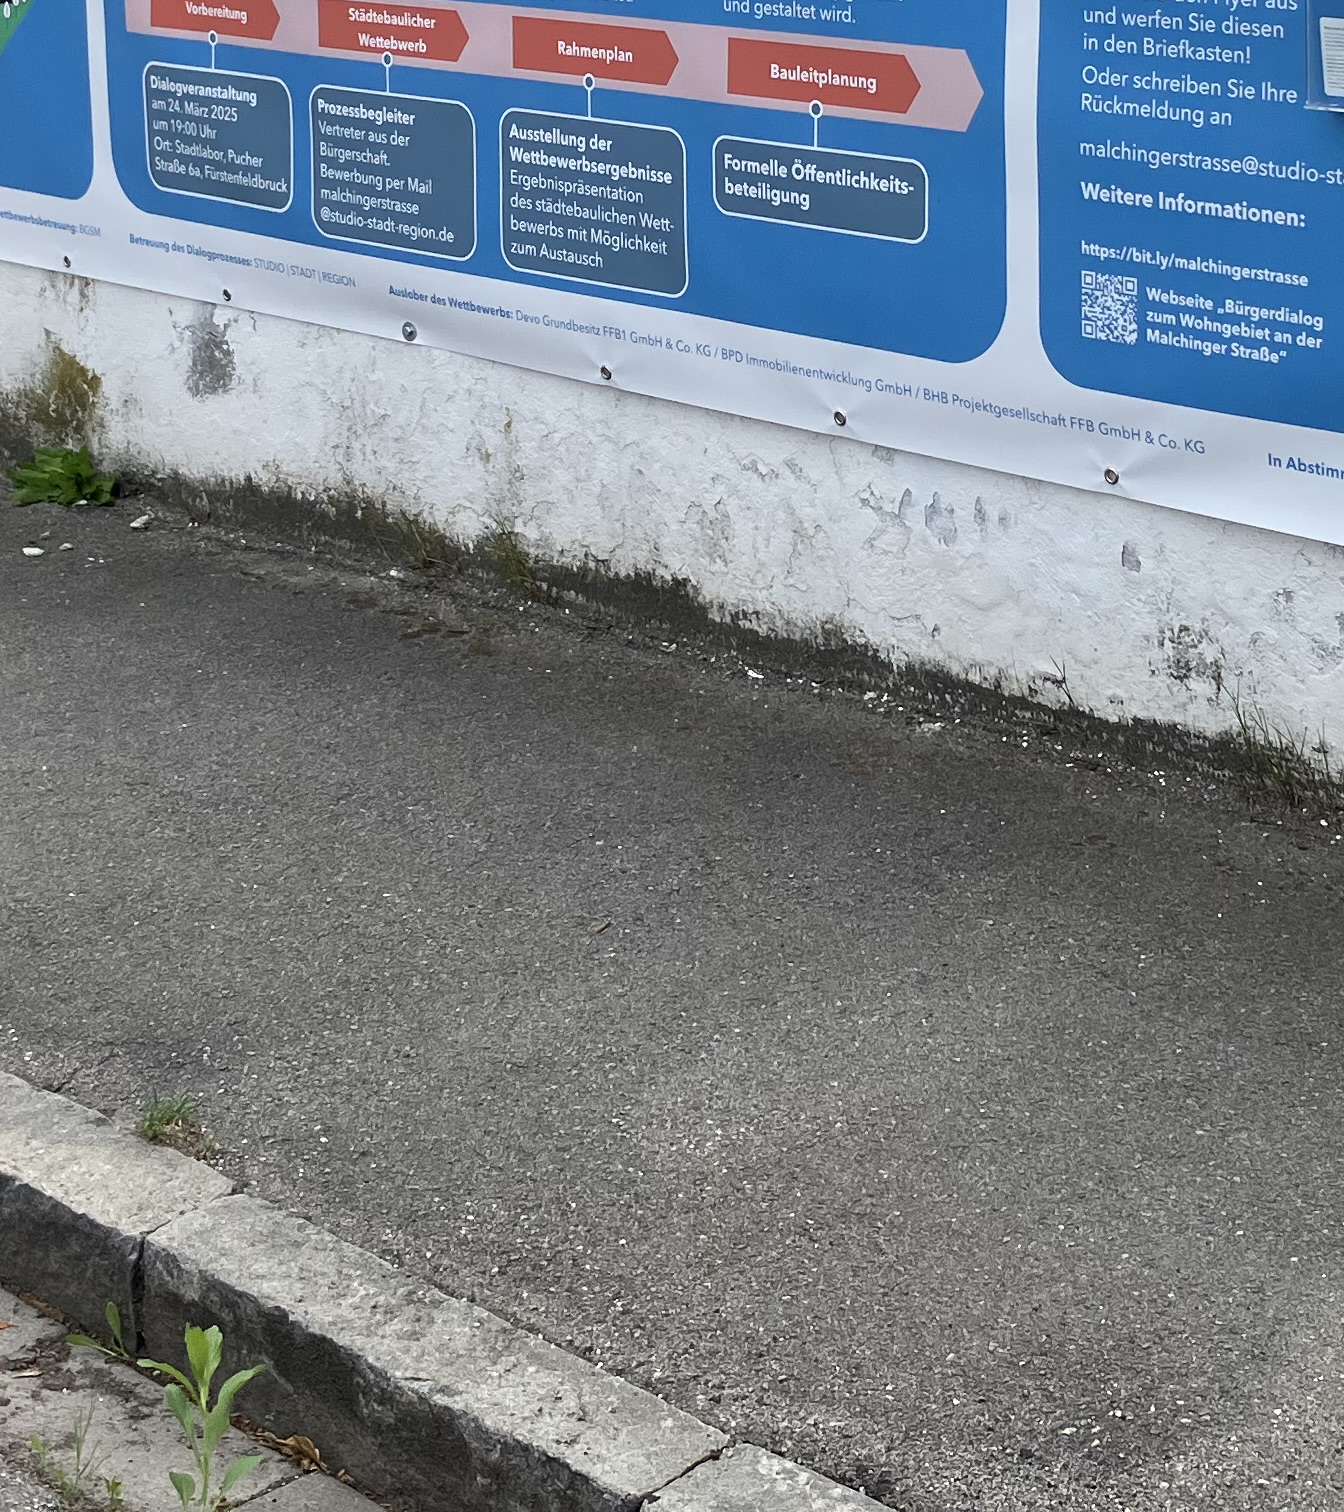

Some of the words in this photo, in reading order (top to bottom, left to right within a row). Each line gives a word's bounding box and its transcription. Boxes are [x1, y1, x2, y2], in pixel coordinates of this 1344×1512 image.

[185, 1, 247, 24] Vorbereitung
[349, 7, 435, 28] Städtebaulicher
[754, 0, 816, 19] gestaltet
[819, 5, 855, 23] wird.
[1084, 6, 1116, 24] und
[1122, 9, 1182, 30] werfen
[1189, 13, 1215, 32] Sie
[1222, 15, 1283, 38] diesen
[358, 33, 426, 52] Wettebwerb
[558, 41, 632, 64] Rahmenplan
[1084, 33, 1098, 50] in
[1104, 33, 1137, 53] den
[1143, 37, 1250, 63] Briefkasten!
[150, 75, 256, 105] Dialogveranstaltung
[771, 64, 876, 93] Bauleitplanung
[1082, 65, 1128, 86] Oder
[1133, 71, 1220, 96] schreiben
[1227, 79, 1255, 99] Sie
[1262, 81, 1297, 103] Ihre
[152, 99, 166, 110] am
[168, 98, 183, 112] 24.
[184, 100, 208, 117] März
[211, 104, 237, 121] 2025
[318, 98, 415, 125] Prozessbegleiter
[1082, 93, 1203, 128] Rückmeldung
[1210, 111, 1231, 125] an
[509, 123, 585, 152] Ausstellung
[589, 133, 612, 151] der
[509, 146, 672, 183] Wettbewerbsergebnisse
[724, 153, 787, 177] Formelle
[792, 163, 913, 194] Öffentlichkeits-
[510, 169, 643, 203] Ergebnispräsentation
[725, 177, 809, 210] beteiligung
[1080, 181, 1153, 207] Weitere
[1159, 191, 1305, 227] Informationen:
[320, 206, 454, 242] @studio-stadt-region.de
[1081, 240, 1308, 286] https://bit.ly/malchingerstrasse
[1146, 287, 1213, 310] Webseite
[1146, 311, 1176, 325] zum
[1179, 313, 1270, 341] Wohngebiet
[1274, 332, 1291, 344] an
[1296, 331, 1322, 348] der
[1147, 328, 1227, 355] Malchinger
[721, 348, 744, 363] BPD
[746, 353, 871, 392] Immobilienentwicklung
[875, 378, 913, 396] GmbH
[923, 388, 948, 404] BHB
[952, 394, 1067, 427] Projektgesellschaft
[1070, 416, 1094, 432] FFB
[1098, 422, 1140, 441] GmbH
[1145, 430, 1154, 444] &
[1158, 433, 1180, 449] Co.
[1184, 438, 1205, 454] KG
[1268, 453, 1281, 468] In
